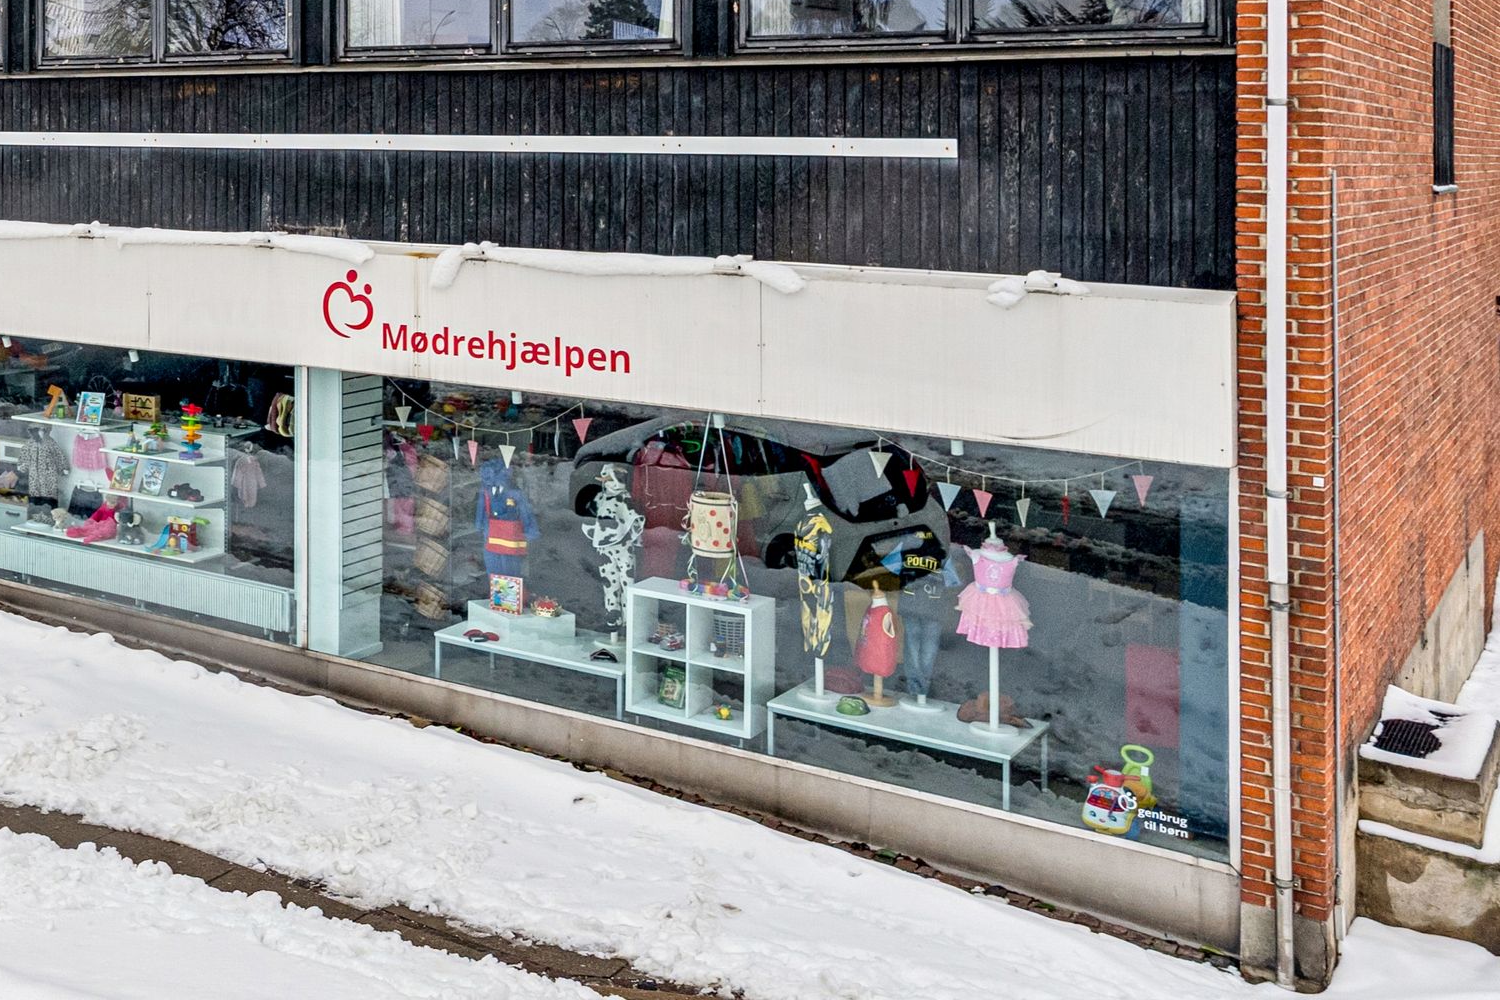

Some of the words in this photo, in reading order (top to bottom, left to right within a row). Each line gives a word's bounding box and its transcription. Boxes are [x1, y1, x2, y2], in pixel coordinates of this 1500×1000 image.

[382, 322, 631, 377] Mødrehjælpen
[907, 556, 938, 571] POLITI
[1137, 808, 1188, 828] genbrug
[1144, 820, 1156, 831] til
[1159, 823, 1189, 838] børn
